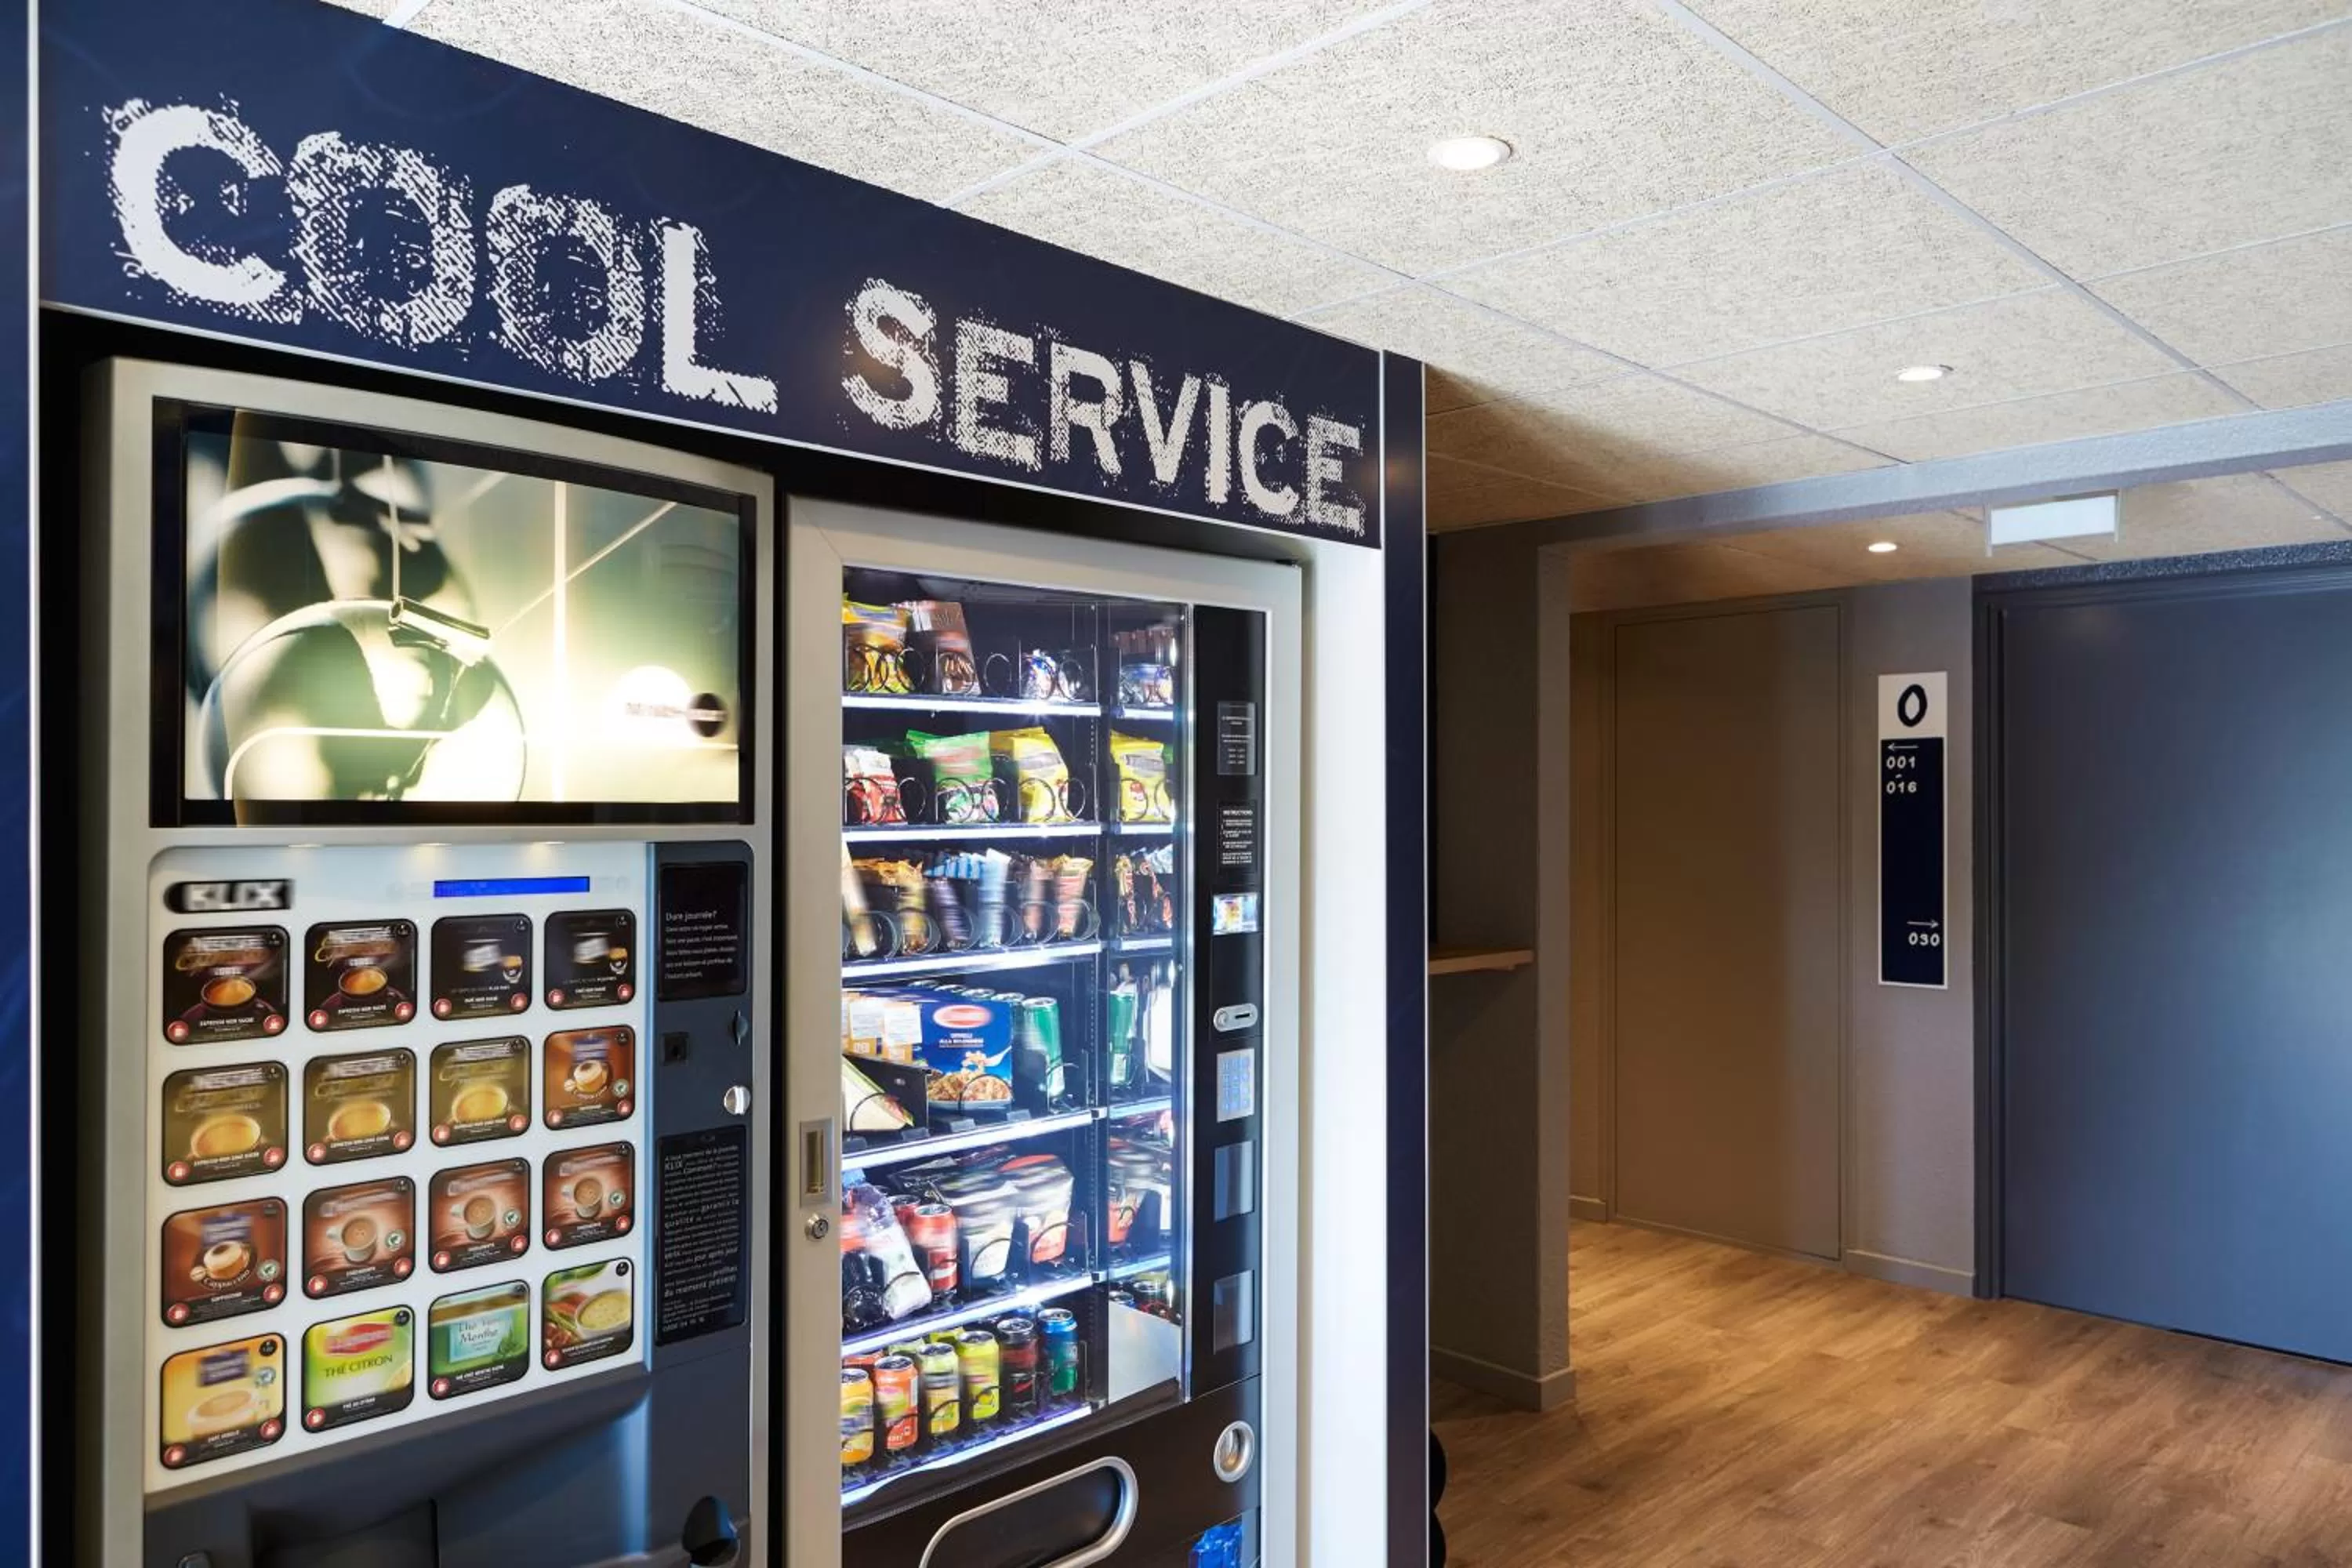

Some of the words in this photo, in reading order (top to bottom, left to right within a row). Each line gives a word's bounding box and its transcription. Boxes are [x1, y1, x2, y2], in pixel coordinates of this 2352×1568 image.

[106, 96, 778, 414] COOL
[842, 278, 1366, 537] SERVICE
[1886, 756, 1916, 769] 001
[1886, 781, 1918, 794] 016
